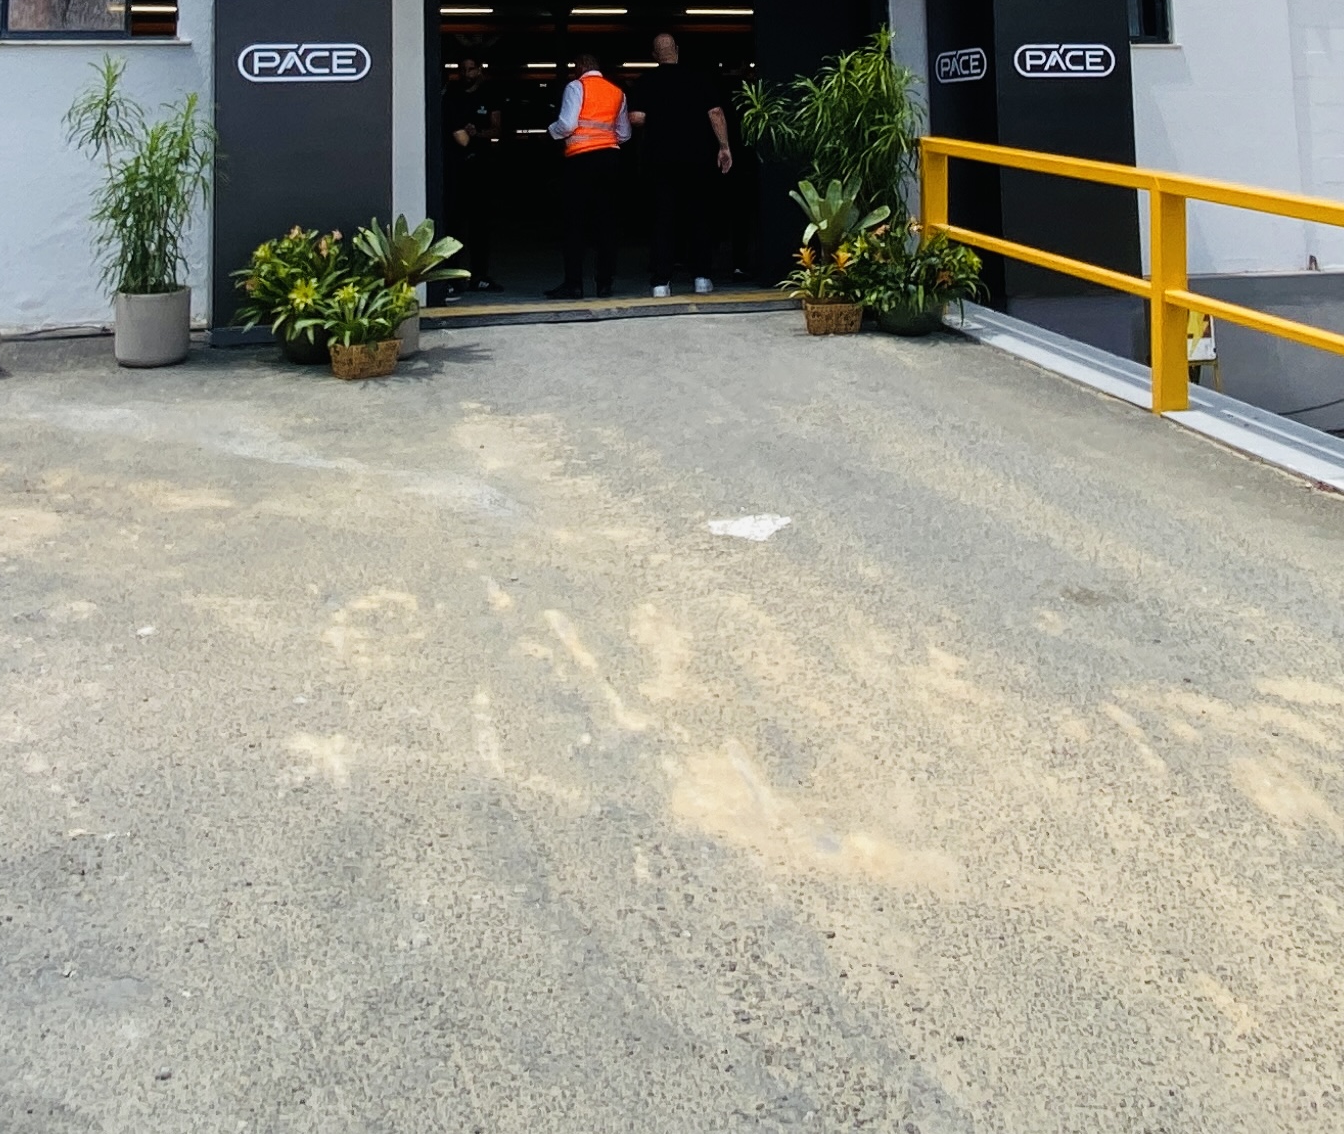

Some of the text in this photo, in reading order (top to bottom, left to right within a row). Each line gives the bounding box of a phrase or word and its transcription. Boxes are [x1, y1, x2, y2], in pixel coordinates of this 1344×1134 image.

[253, 50, 357, 75] PACE
[940, 53, 981, 78] PACE
[1025, 49, 1105, 72] PACE
